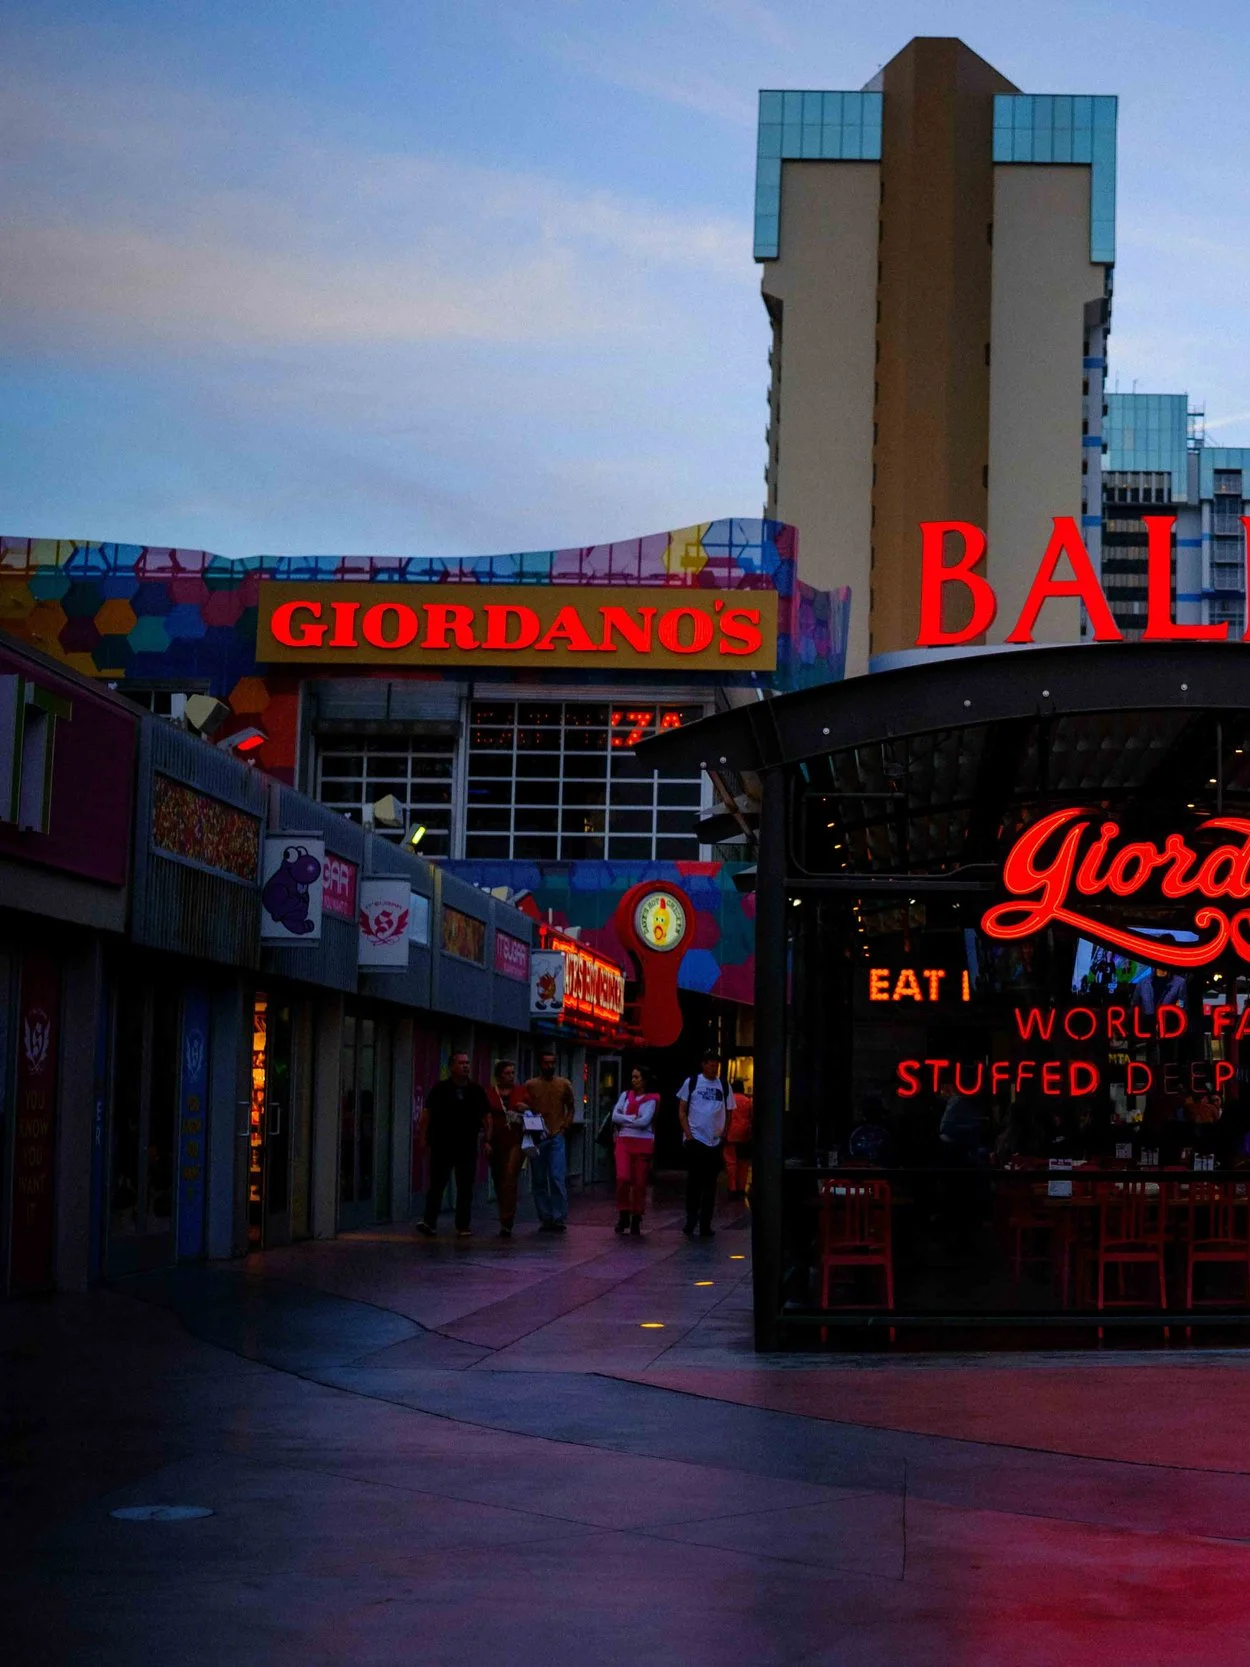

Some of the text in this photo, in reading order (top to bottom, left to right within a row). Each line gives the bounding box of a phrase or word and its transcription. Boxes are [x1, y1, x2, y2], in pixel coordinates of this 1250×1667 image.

[270, 599, 764, 656] GIORDANO'S
[869, 967, 946, 1002] EAT
[1013, 1005, 1189, 1041] WORLD
[895, 1058, 1099, 1098] STUFFED
[1126, 1059, 1237, 1097] DEEP
